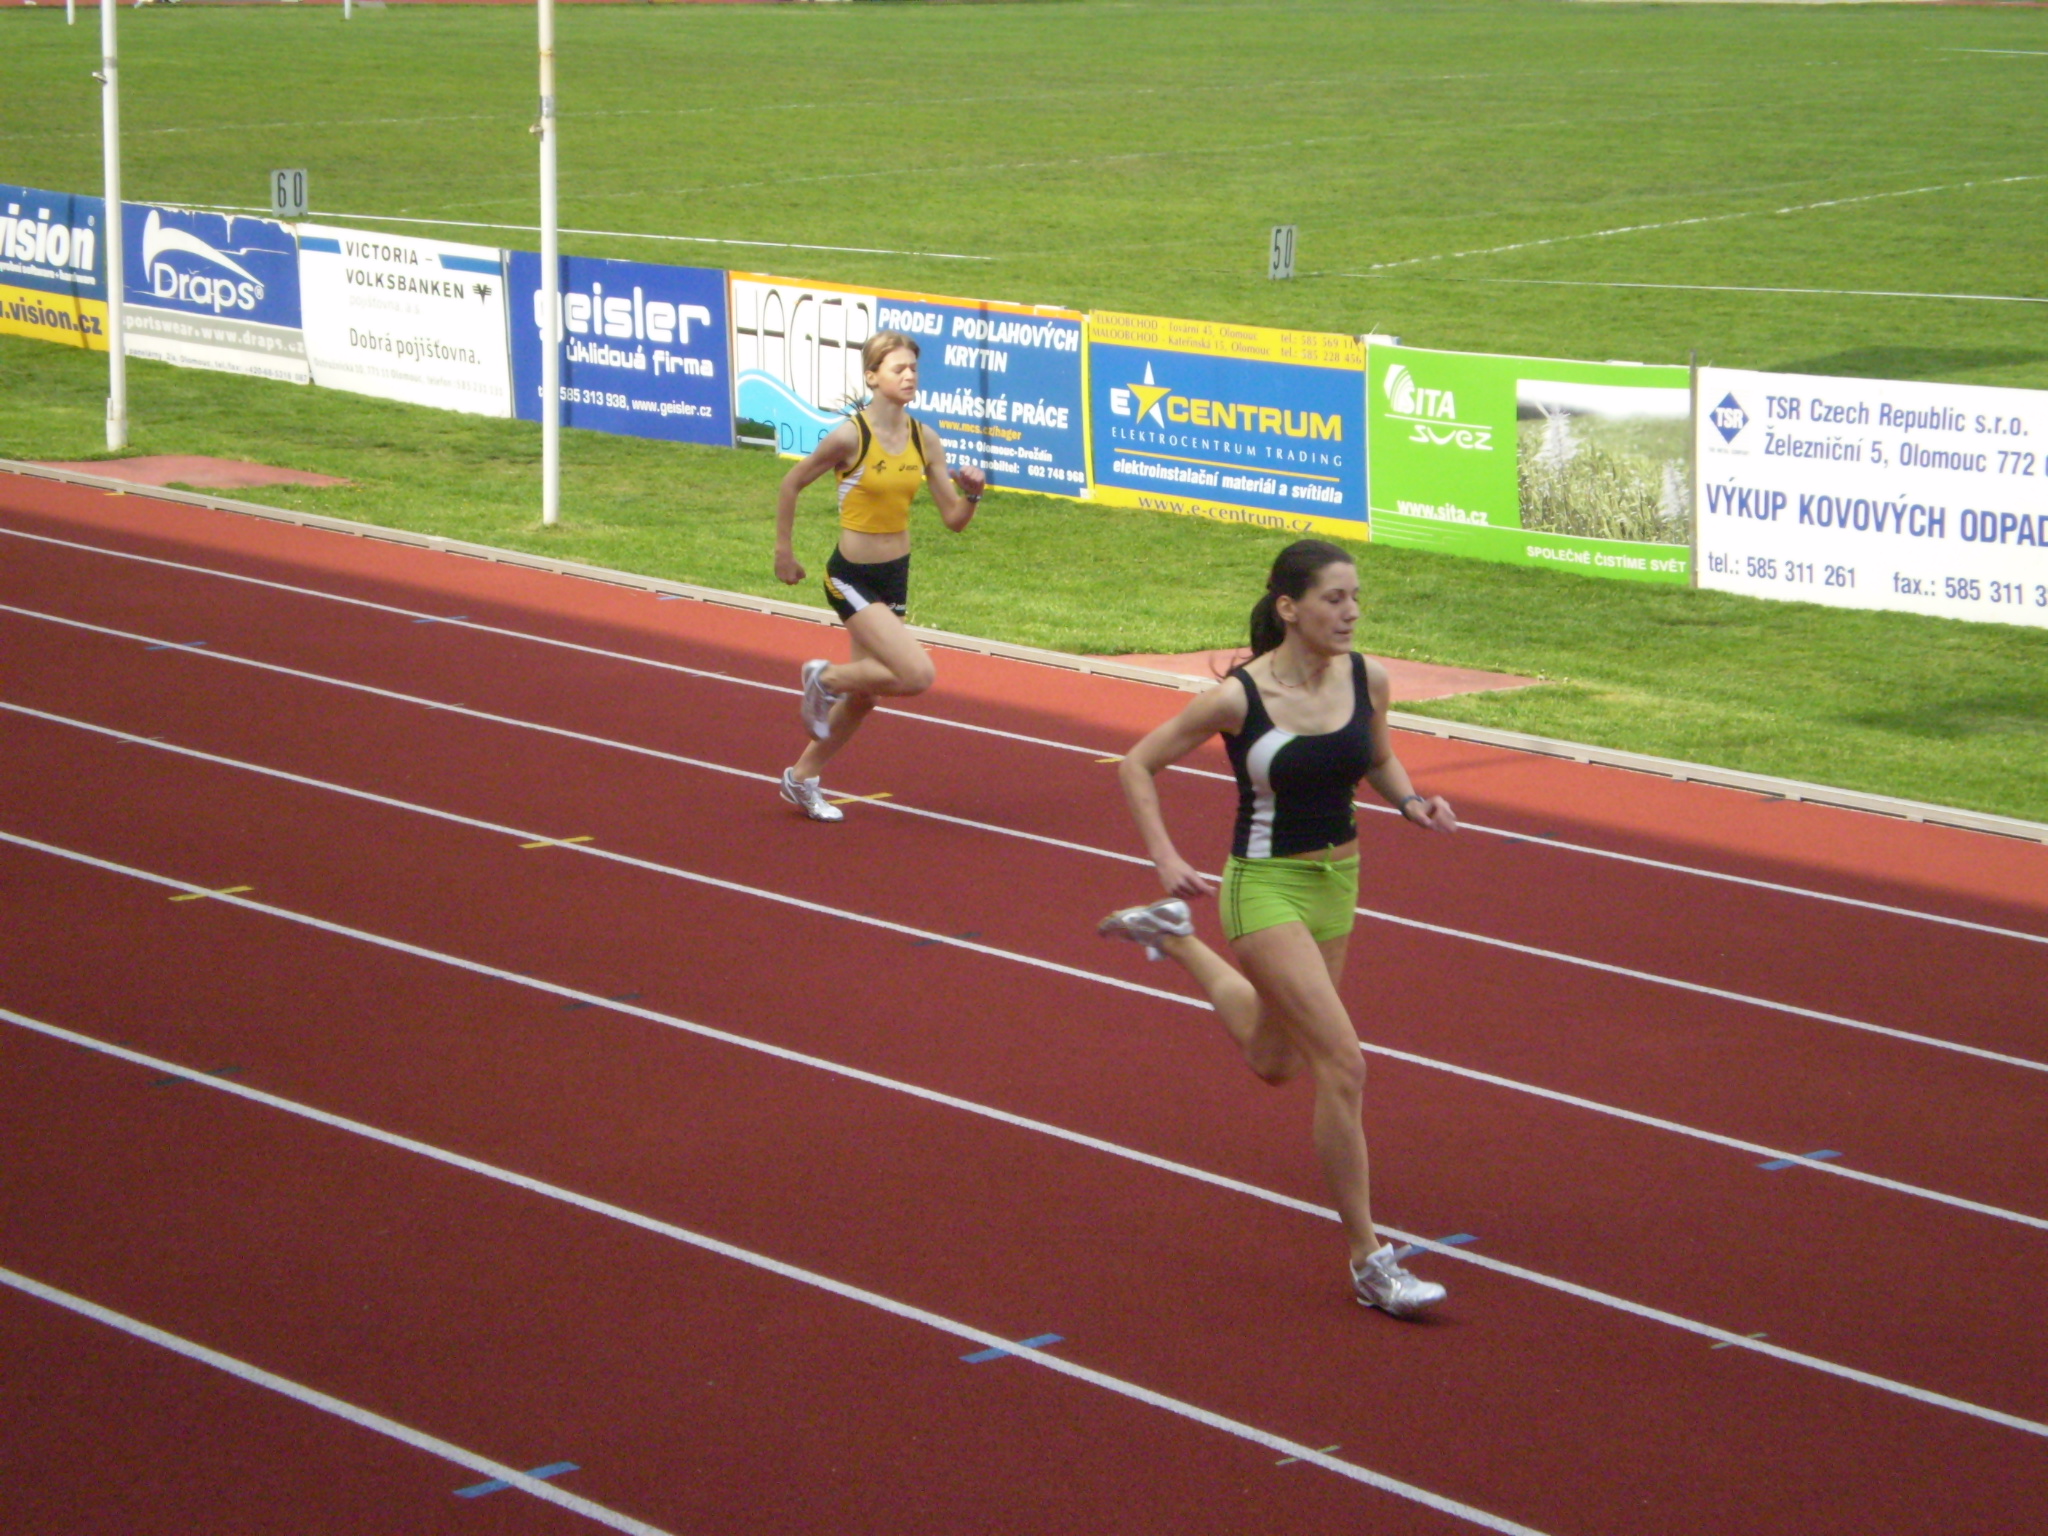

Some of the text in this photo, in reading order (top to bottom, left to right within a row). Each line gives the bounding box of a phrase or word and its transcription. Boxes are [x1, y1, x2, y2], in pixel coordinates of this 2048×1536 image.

[278, 172, 302, 208] 60
[346, 241, 419, 266] VICTORIA
[1273, 228, 1293, 270] 50
[153, 262, 256, 313] Draps
[346, 268, 464, 299] VOLKSBANKEN
[123, 314, 193, 337] portswear
[878, 308, 1079, 352] PRODEJ PODLAHOVÝCH
[1096, 315, 1158, 330] ELKOOBCHOD
[1219, 327, 1258, 341] Olomouc
[1302, 335, 1317, 347] 585
[349, 327, 481, 365] Dobrá pojišťovna.
[944, 345, 1007, 373] KRYTIN
[1231, 341, 1270, 355] Olomouc
[653, 349, 713, 376] firma
[559, 386, 580, 402] 585
[583, 390, 603, 406] 313
[606, 393, 629, 411] 938,
[632, 399, 712, 417] www.geisler.cz
[904, 388, 1069, 429] DLAHÁŘSKÉ PRÁCE
[1400, 387, 1456, 420] SITA
[1766, 395, 2029, 437] TSR Czech Republic s.r.o.
[939, 419, 1023, 441] www.mcs.cz/hager
[1716, 407, 1743, 429] TSR
[976, 440, 1053, 462] Olomouc-Droždín
[1111, 426, 1342, 467] ELEKTROCENTRUM TRADING
[1765, 426, 1863, 462] Železniční
[1871, 441, 1888, 468] 5,
[1900, 442, 1987, 473] Olomouc
[1997, 450, 2035, 476] 772
[1028, 465, 1045, 478] 602
[1047, 467, 1065, 480] 748
[1113, 458, 1343, 504] elektroinstalační materiál a svítidla
[1139, 496, 1312, 532] www.e-centrum.cz
[1397, 500, 1488, 526] www.sita.cz
[1706, 477, 1787, 522] VÝKUP
[1799, 492, 1945, 539] KOVOVÝCH
[1527, 545, 1687, 573] SPOLEČNĚ ČISTÍME SVĚT
[1708, 551, 1739, 575] tel.:
[1746, 556, 1777, 580] 585
[1785, 560, 1814, 584] 311
[1824, 564, 1856, 589] 261
[1893, 572, 1936, 597] fax.:
[1944, 577, 1981, 601] 585
[1990, 581, 2023, 605] 311
